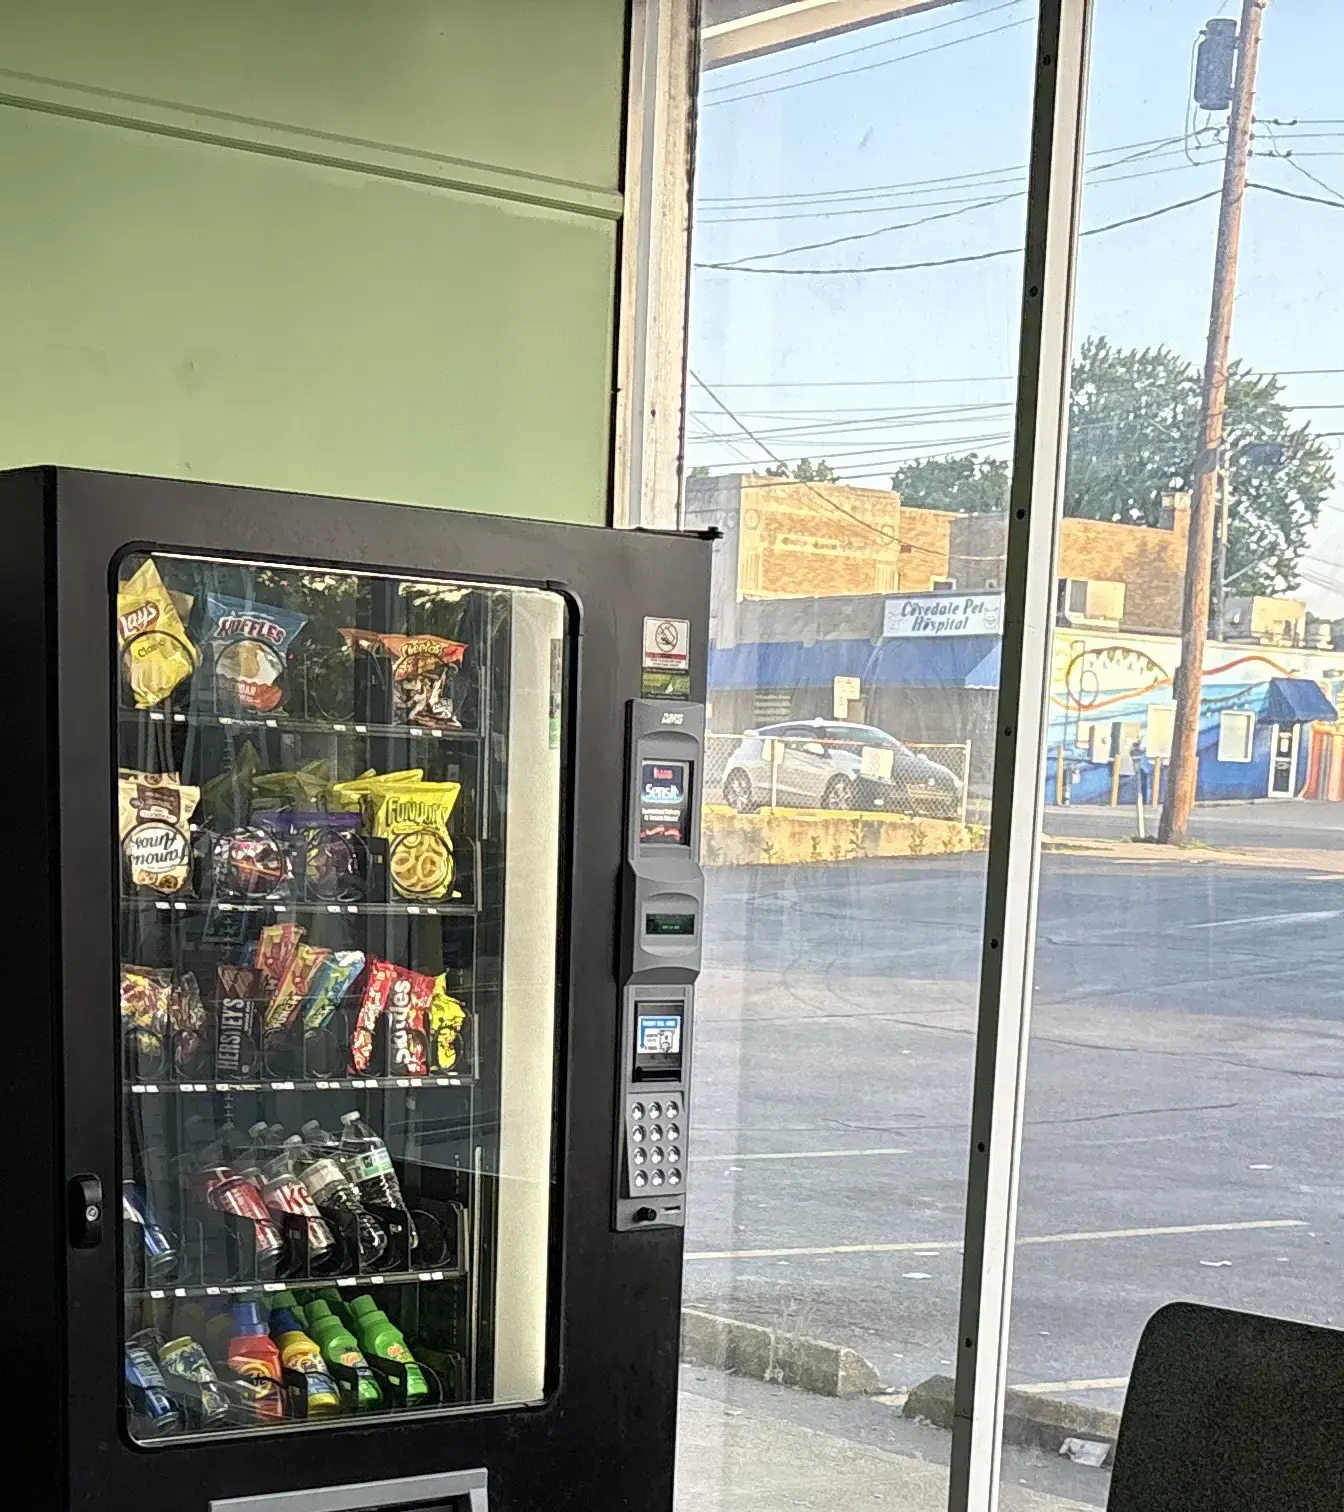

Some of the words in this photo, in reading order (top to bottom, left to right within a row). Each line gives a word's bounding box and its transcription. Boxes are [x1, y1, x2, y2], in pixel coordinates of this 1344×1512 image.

[963, 599, 985, 614] Pet
[217, 617, 287, 644] RUFFLES
[911, 616, 969, 634] Hospital
